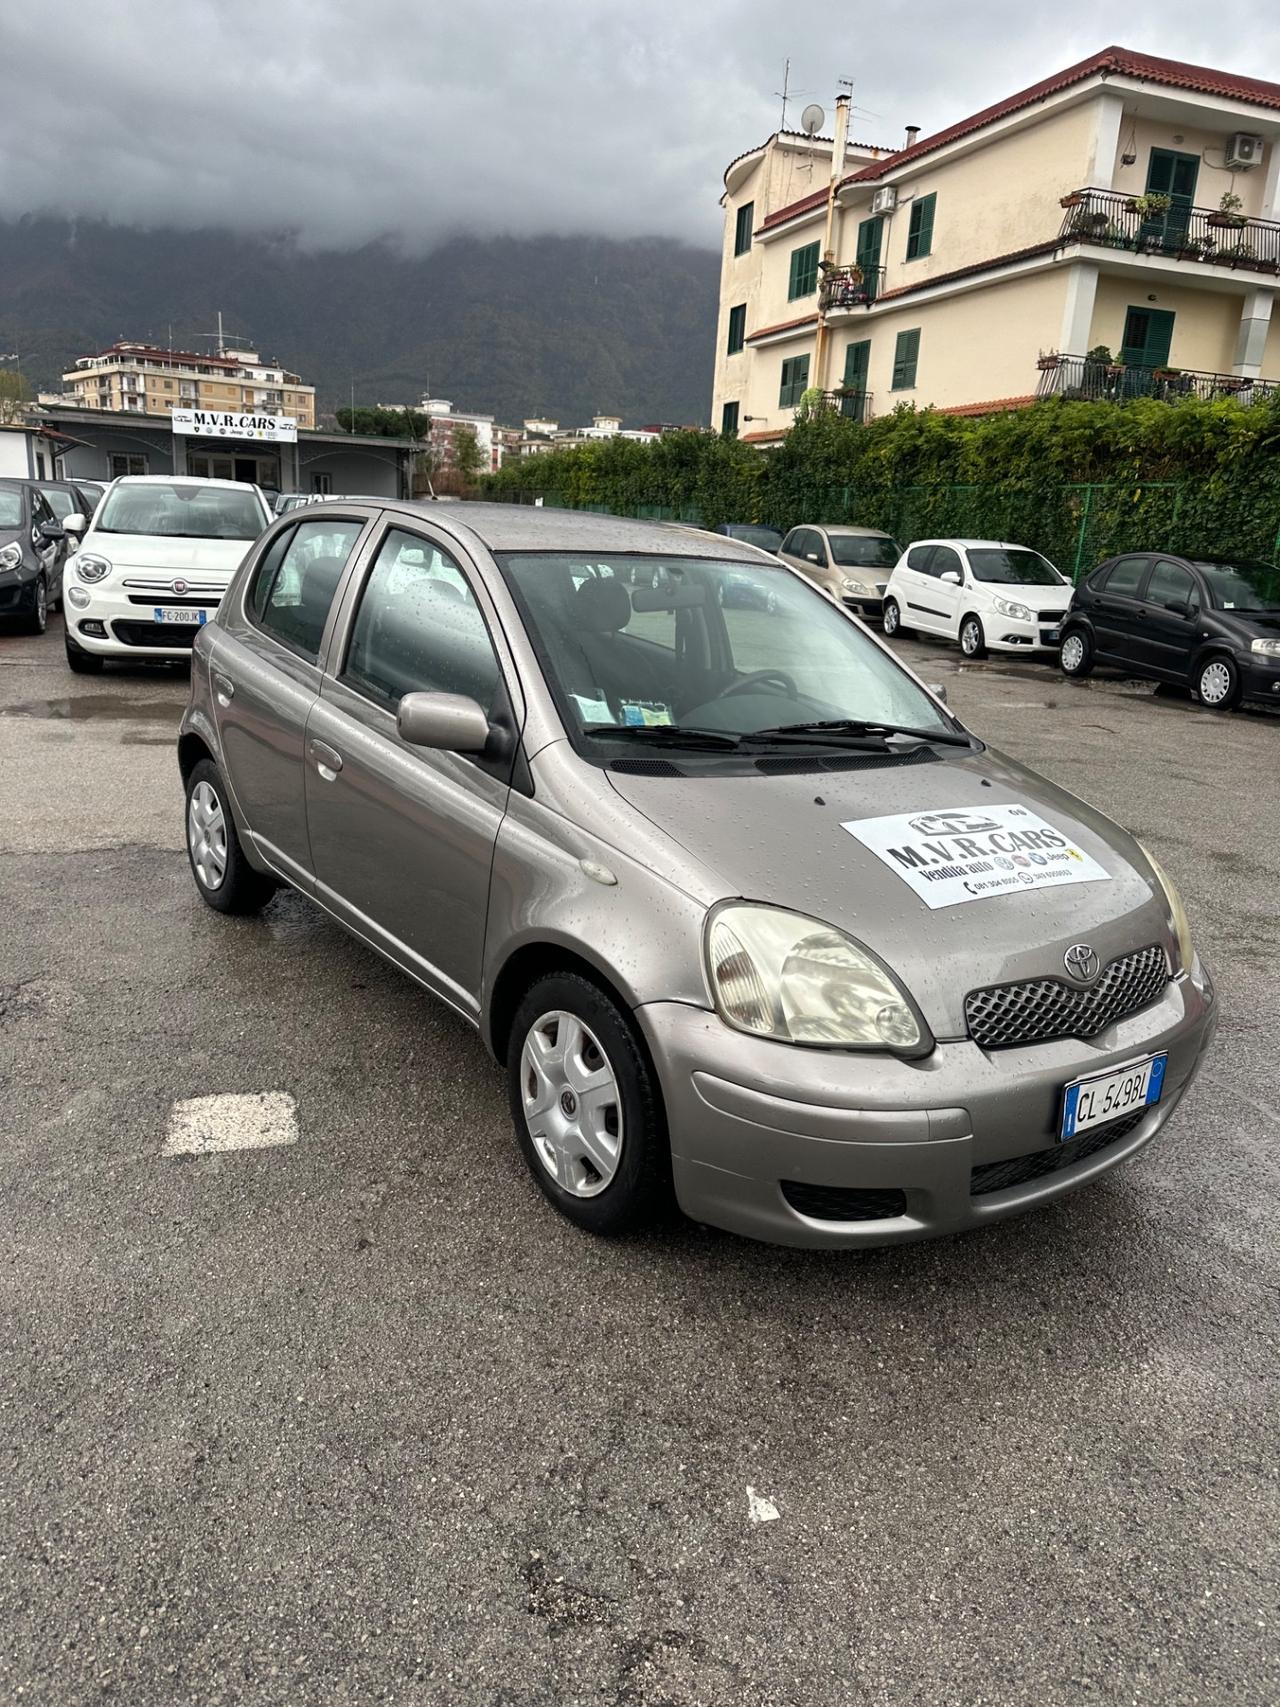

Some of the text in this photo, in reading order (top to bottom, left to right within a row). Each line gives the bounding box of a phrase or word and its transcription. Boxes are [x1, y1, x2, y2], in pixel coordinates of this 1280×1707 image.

[162, 611, 199, 622] FC 200JK
[1047, 852, 1070, 861] Jeep
[918, 860, 994, 882] Vendita auto
[1077, 1072, 1146, 1122] CL 549BL
